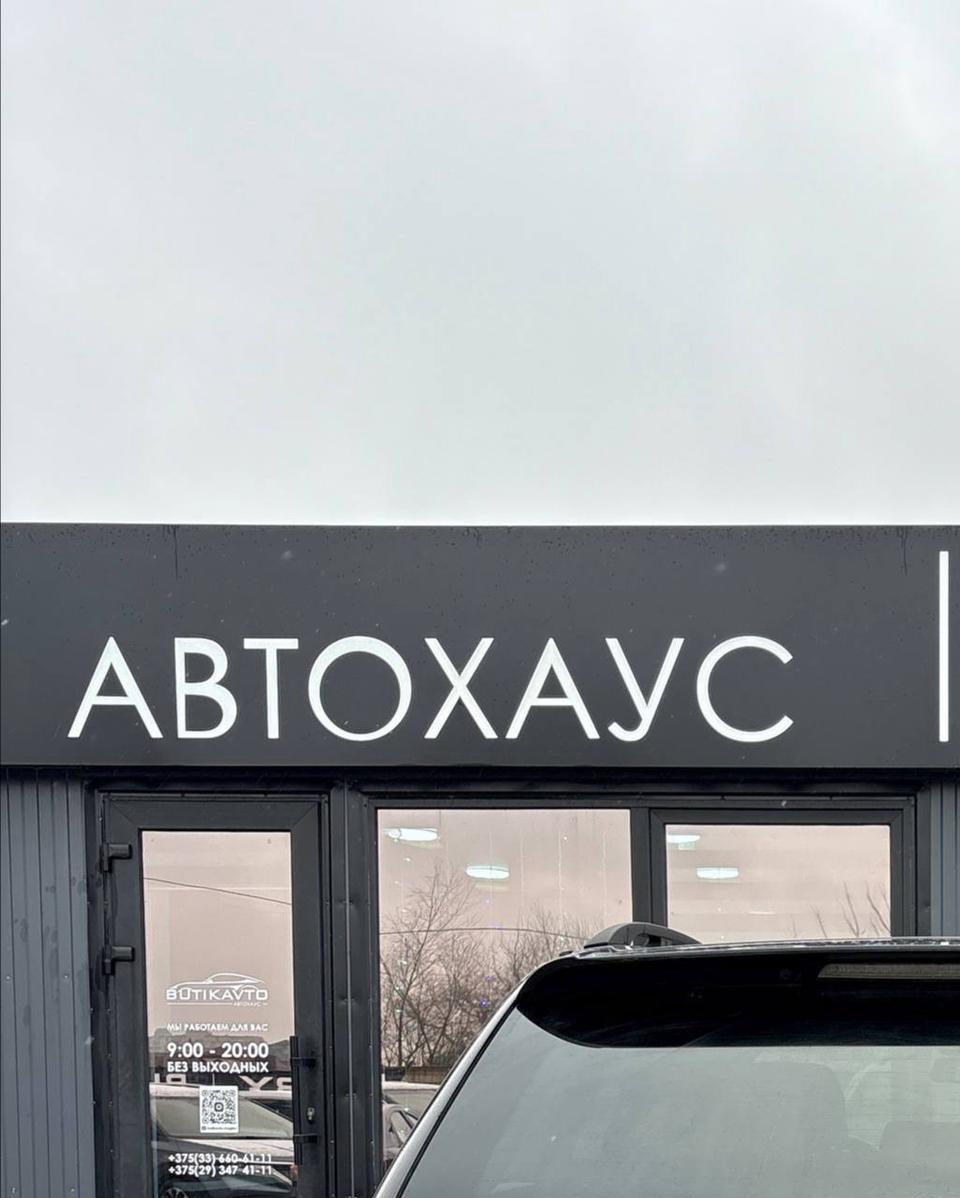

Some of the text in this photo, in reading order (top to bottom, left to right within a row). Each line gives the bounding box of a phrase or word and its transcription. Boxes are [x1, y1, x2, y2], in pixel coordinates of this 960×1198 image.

[68, 636, 795, 743] АВТОХАУС
[166, 988, 268, 1001] BUTIKAVTO
[167, 1023, 269, 1032] МЫ РАБОТАЕМ ДЛЯ ВАС
[167, 1042, 204, 1058] 9:00
[221, 1042, 269, 1058] 20:00
[167, 1061, 269, 1074] БЕЗ ВЫХОДНЫХ
[168, 1153, 272, 1165] +375(33) 660-61-11
[168, 1165, 216, 1177] +375(29)
